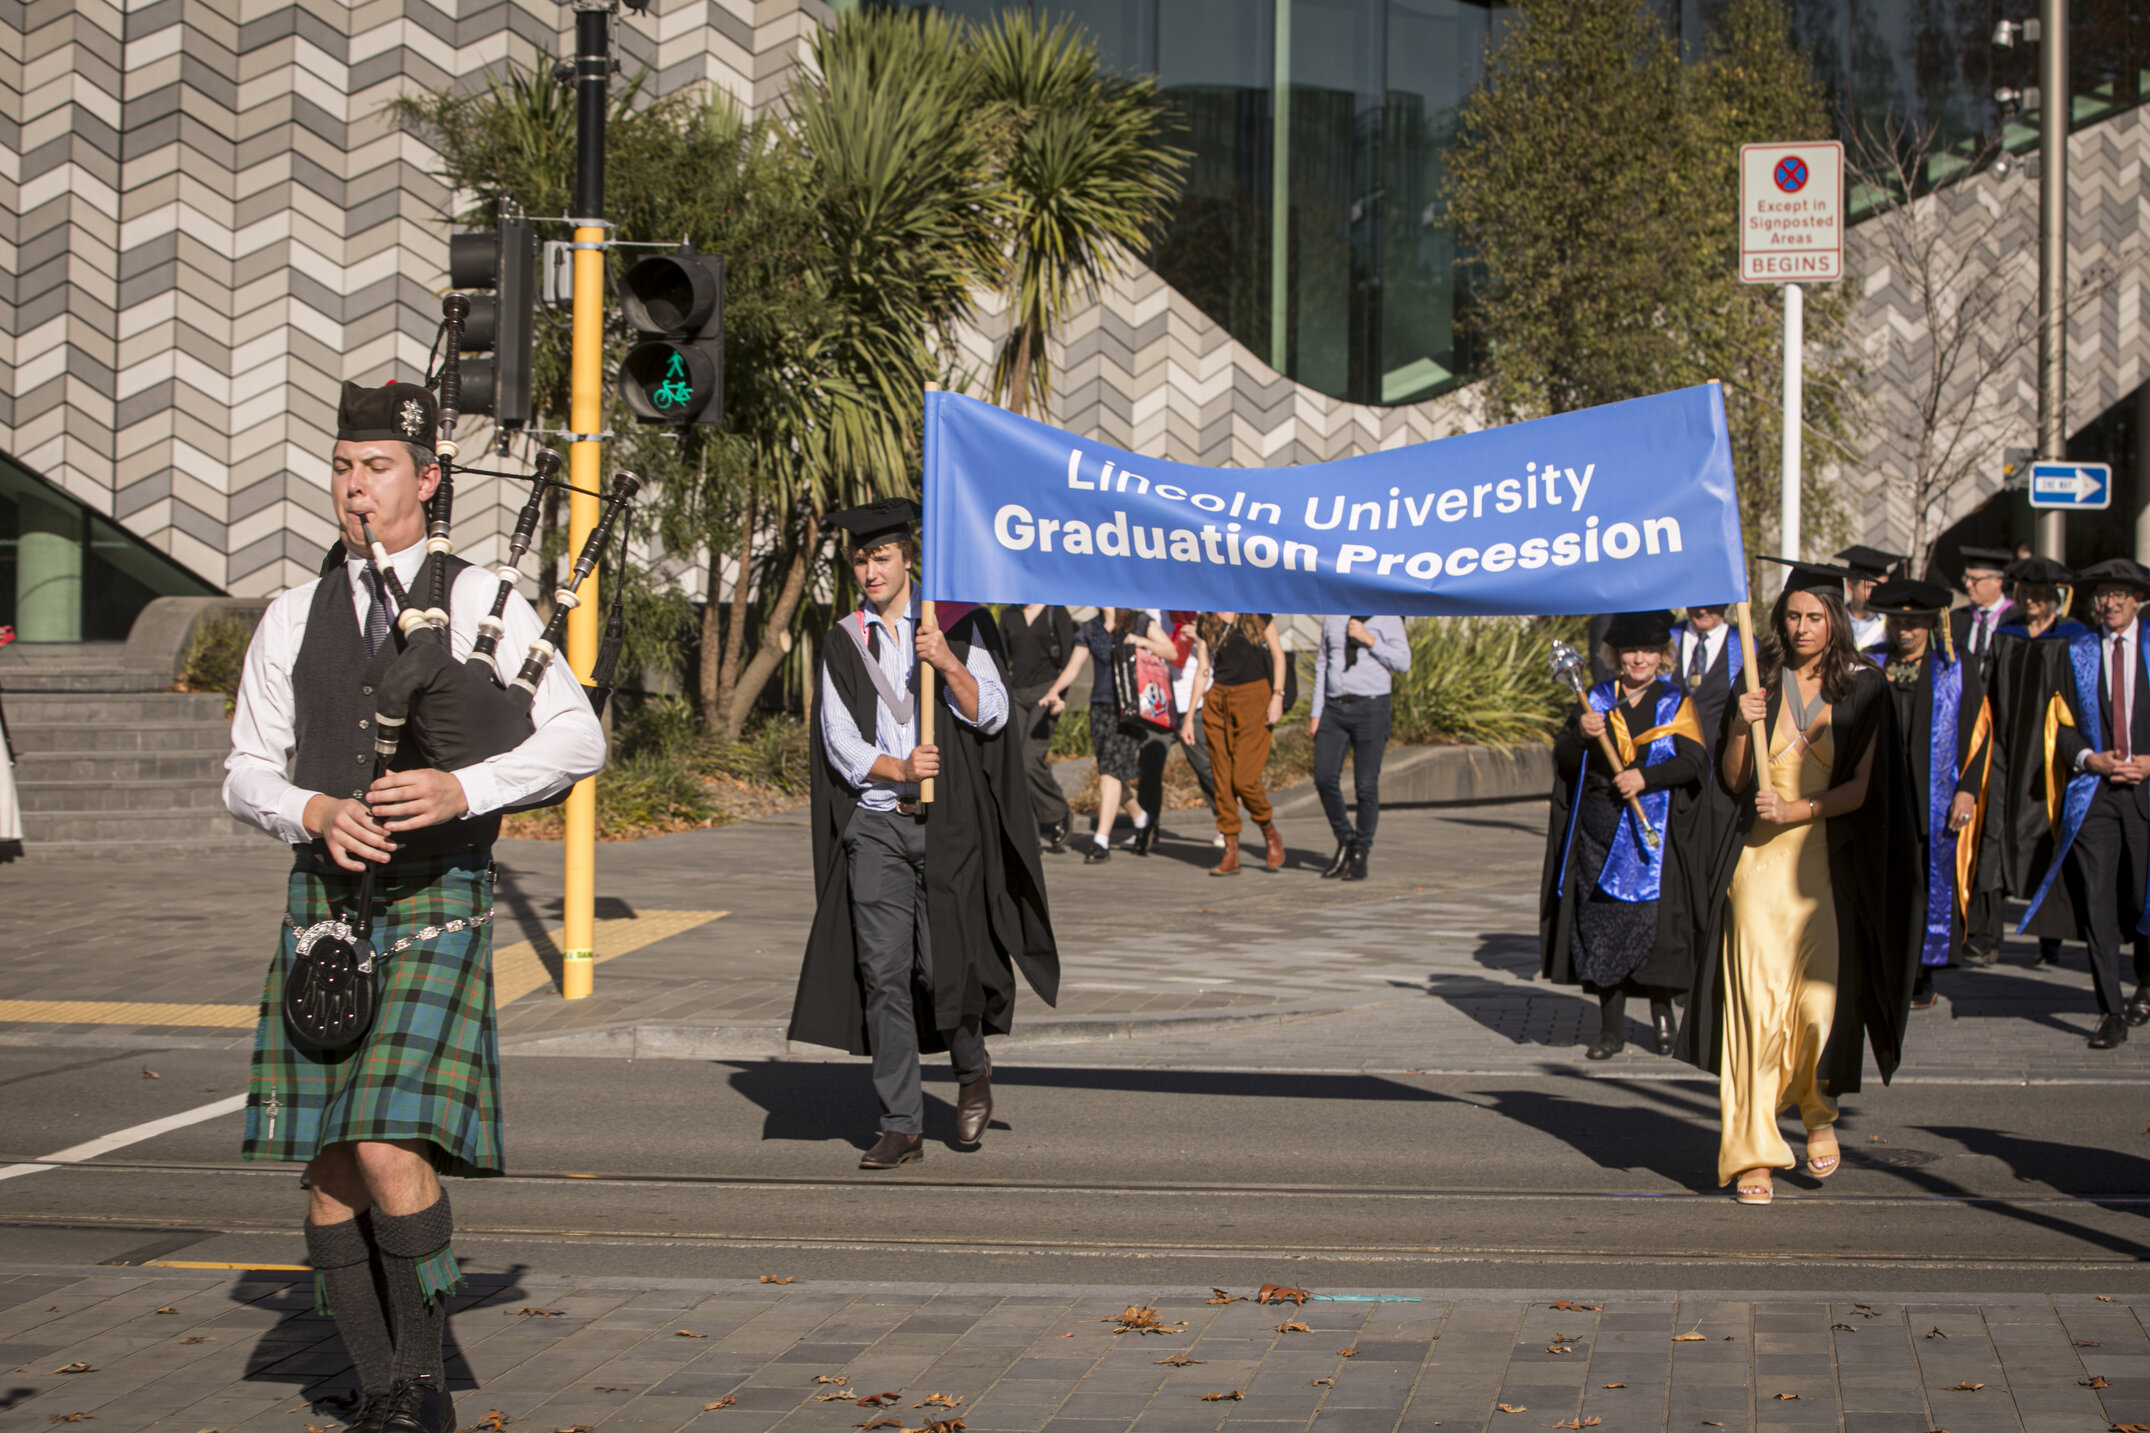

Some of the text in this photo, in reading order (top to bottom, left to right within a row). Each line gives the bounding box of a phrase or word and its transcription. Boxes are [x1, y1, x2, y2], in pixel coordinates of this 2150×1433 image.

[1757, 199, 1826, 214] Except in
[1750, 214, 1834, 231] Signposted
[1770, 232, 1813, 245] Areas
[1752, 256, 1830, 273] BEGINS
[1066, 448, 1596, 531] Lincoln University
[994, 504, 1683, 580] Graduation Procession
